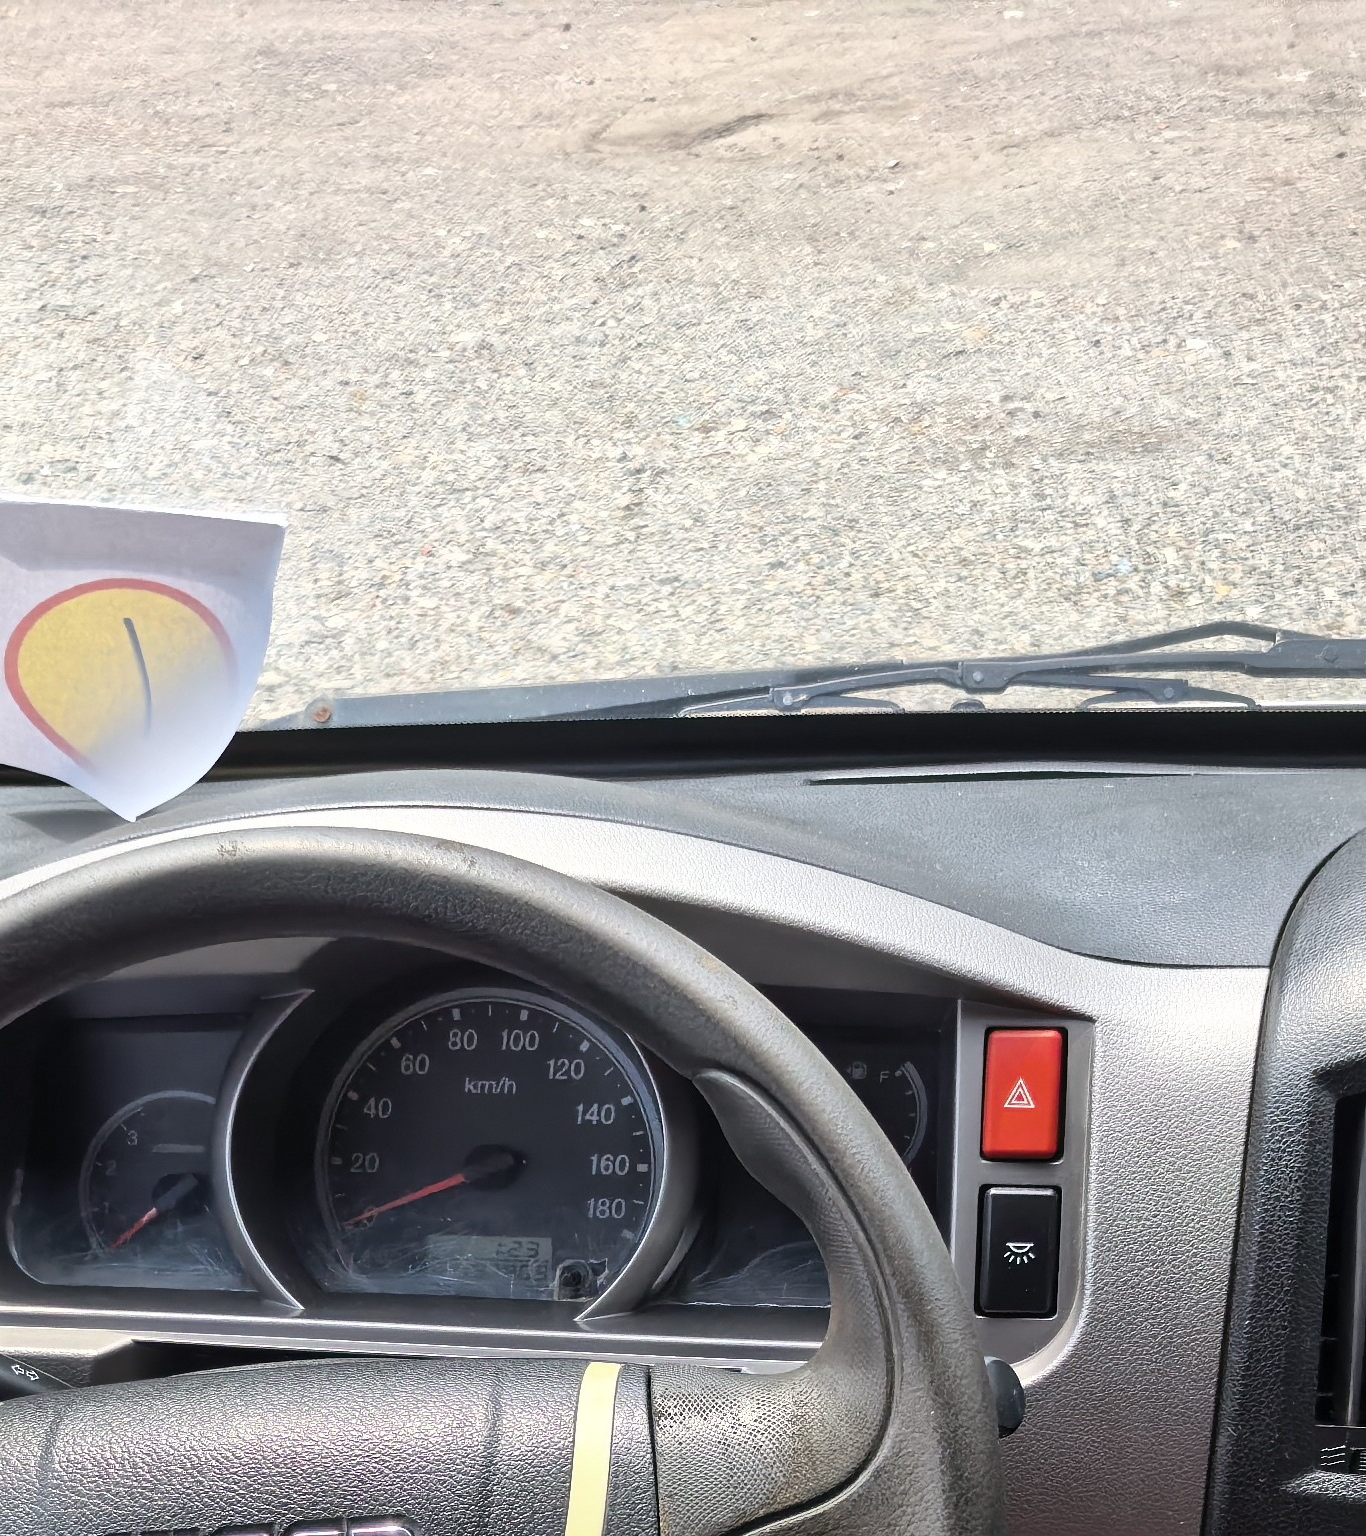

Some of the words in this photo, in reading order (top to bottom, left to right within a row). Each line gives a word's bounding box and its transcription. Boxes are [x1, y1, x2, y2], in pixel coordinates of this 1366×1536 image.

[448, 1029, 477, 1050] 80
[501, 1029, 539, 1051] 100
[400, 1054, 429, 1075] 60
[546, 1058, 584, 1080] 120
[464, 1077, 517, 1095] km/h
[878, 1070, 890, 1083] F
[363, 1097, 393, 1119] 40
[576, 1104, 615, 1125] 140
[127, 1130, 138, 1146] 3
[350, 1152, 380, 1173] 20
[590, 1153, 630, 1176] 160
[587, 1198, 626, 1219] 180
